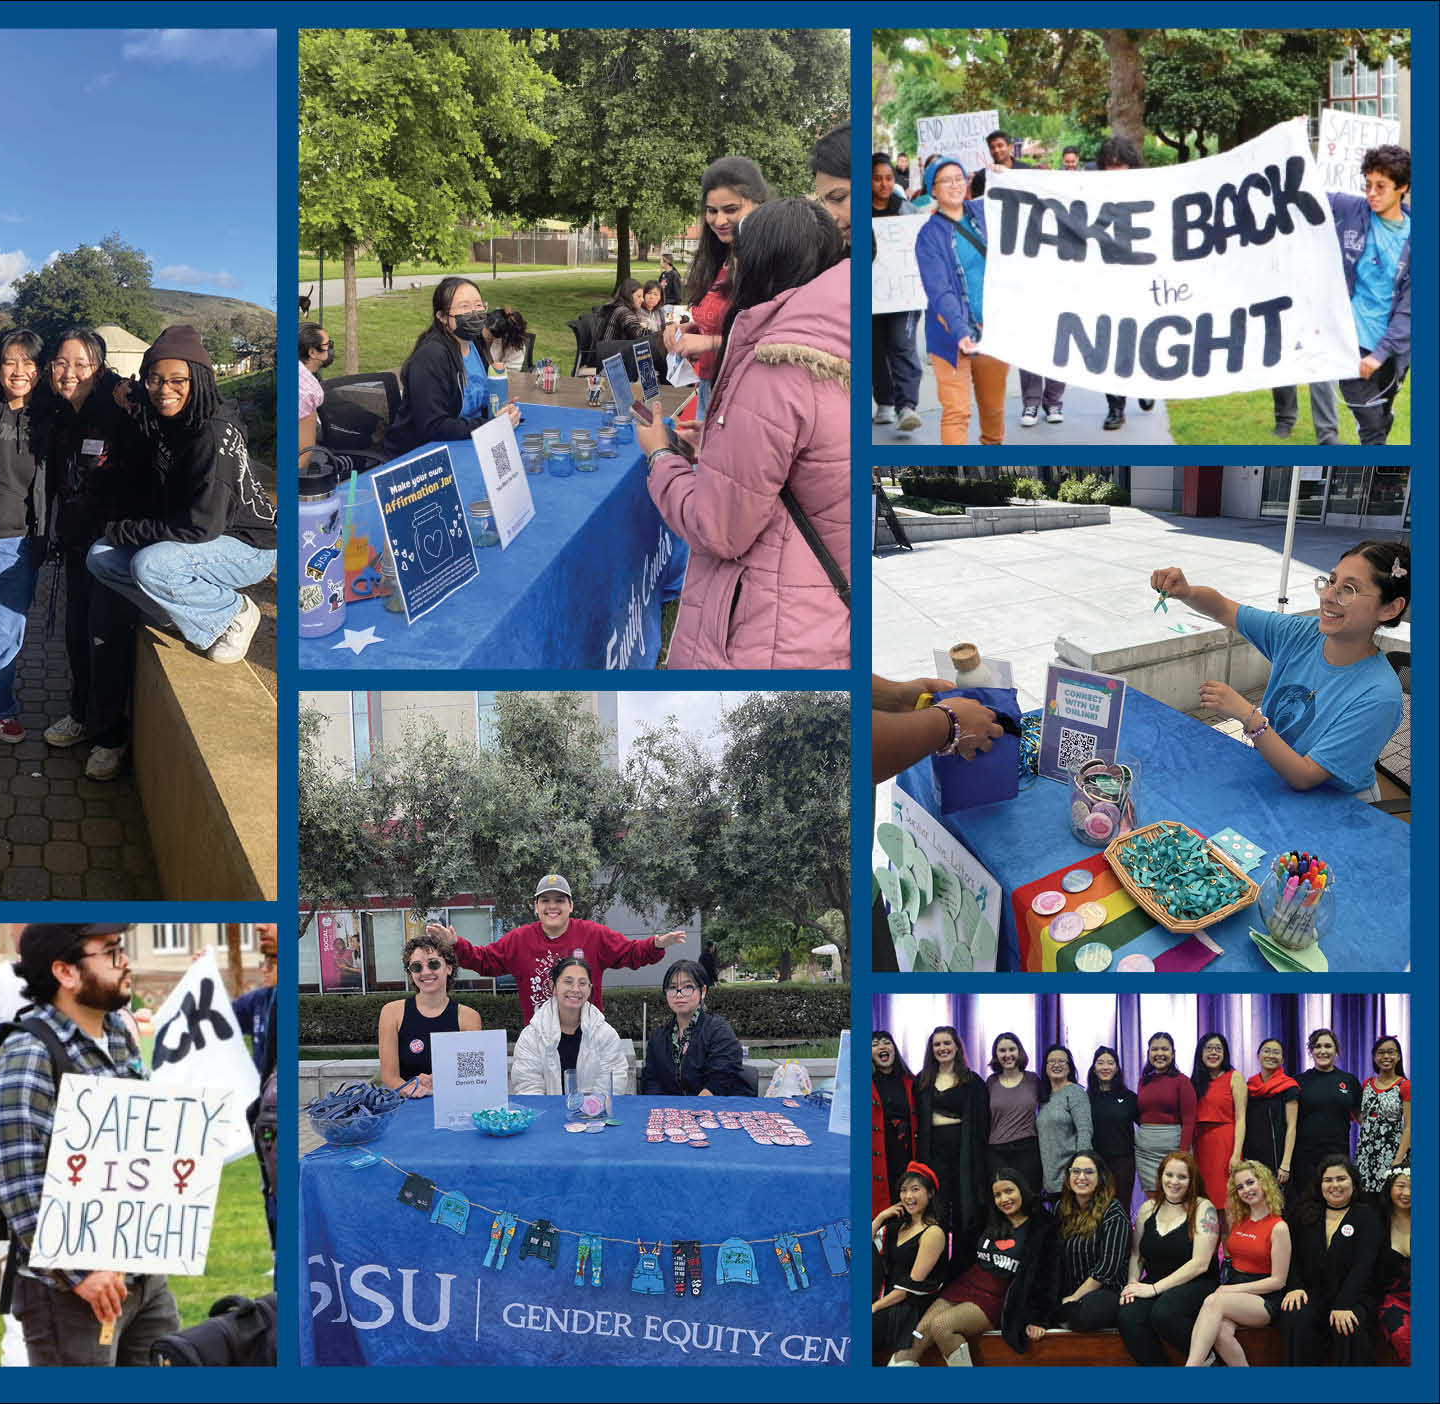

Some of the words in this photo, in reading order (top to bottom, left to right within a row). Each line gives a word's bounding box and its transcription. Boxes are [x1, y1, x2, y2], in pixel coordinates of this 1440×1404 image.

[918, 119, 943, 143] END
[987, 186, 1157, 265] TAKE
[1171, 156, 1325, 262] BACK
[1148, 272, 1194, 306] the
[1053, 296, 1293, 382] NIGHT
[385, 482, 439, 515] Affirmation
[441, 475, 454, 488] Jar
[390, 481, 411, 495] Make
[412, 472, 428, 487] your
[429, 467, 444, 478] own
[1064, 689, 1103, 703] CONNECT
[1065, 698, 1088, 709] WITH
[1089, 703, 1101, 713] US
[65, 1088, 225, 1156] SAFETY
[102, 1158, 151, 1193] IS
[38, 1197, 103, 1259] OUR
[113, 1200, 210, 1262] RIGHT
[983, 1238, 990, 1249] I
[503, 1303, 633, 1339] GENDER
[644, 1316, 773, 1357] EQUITY
